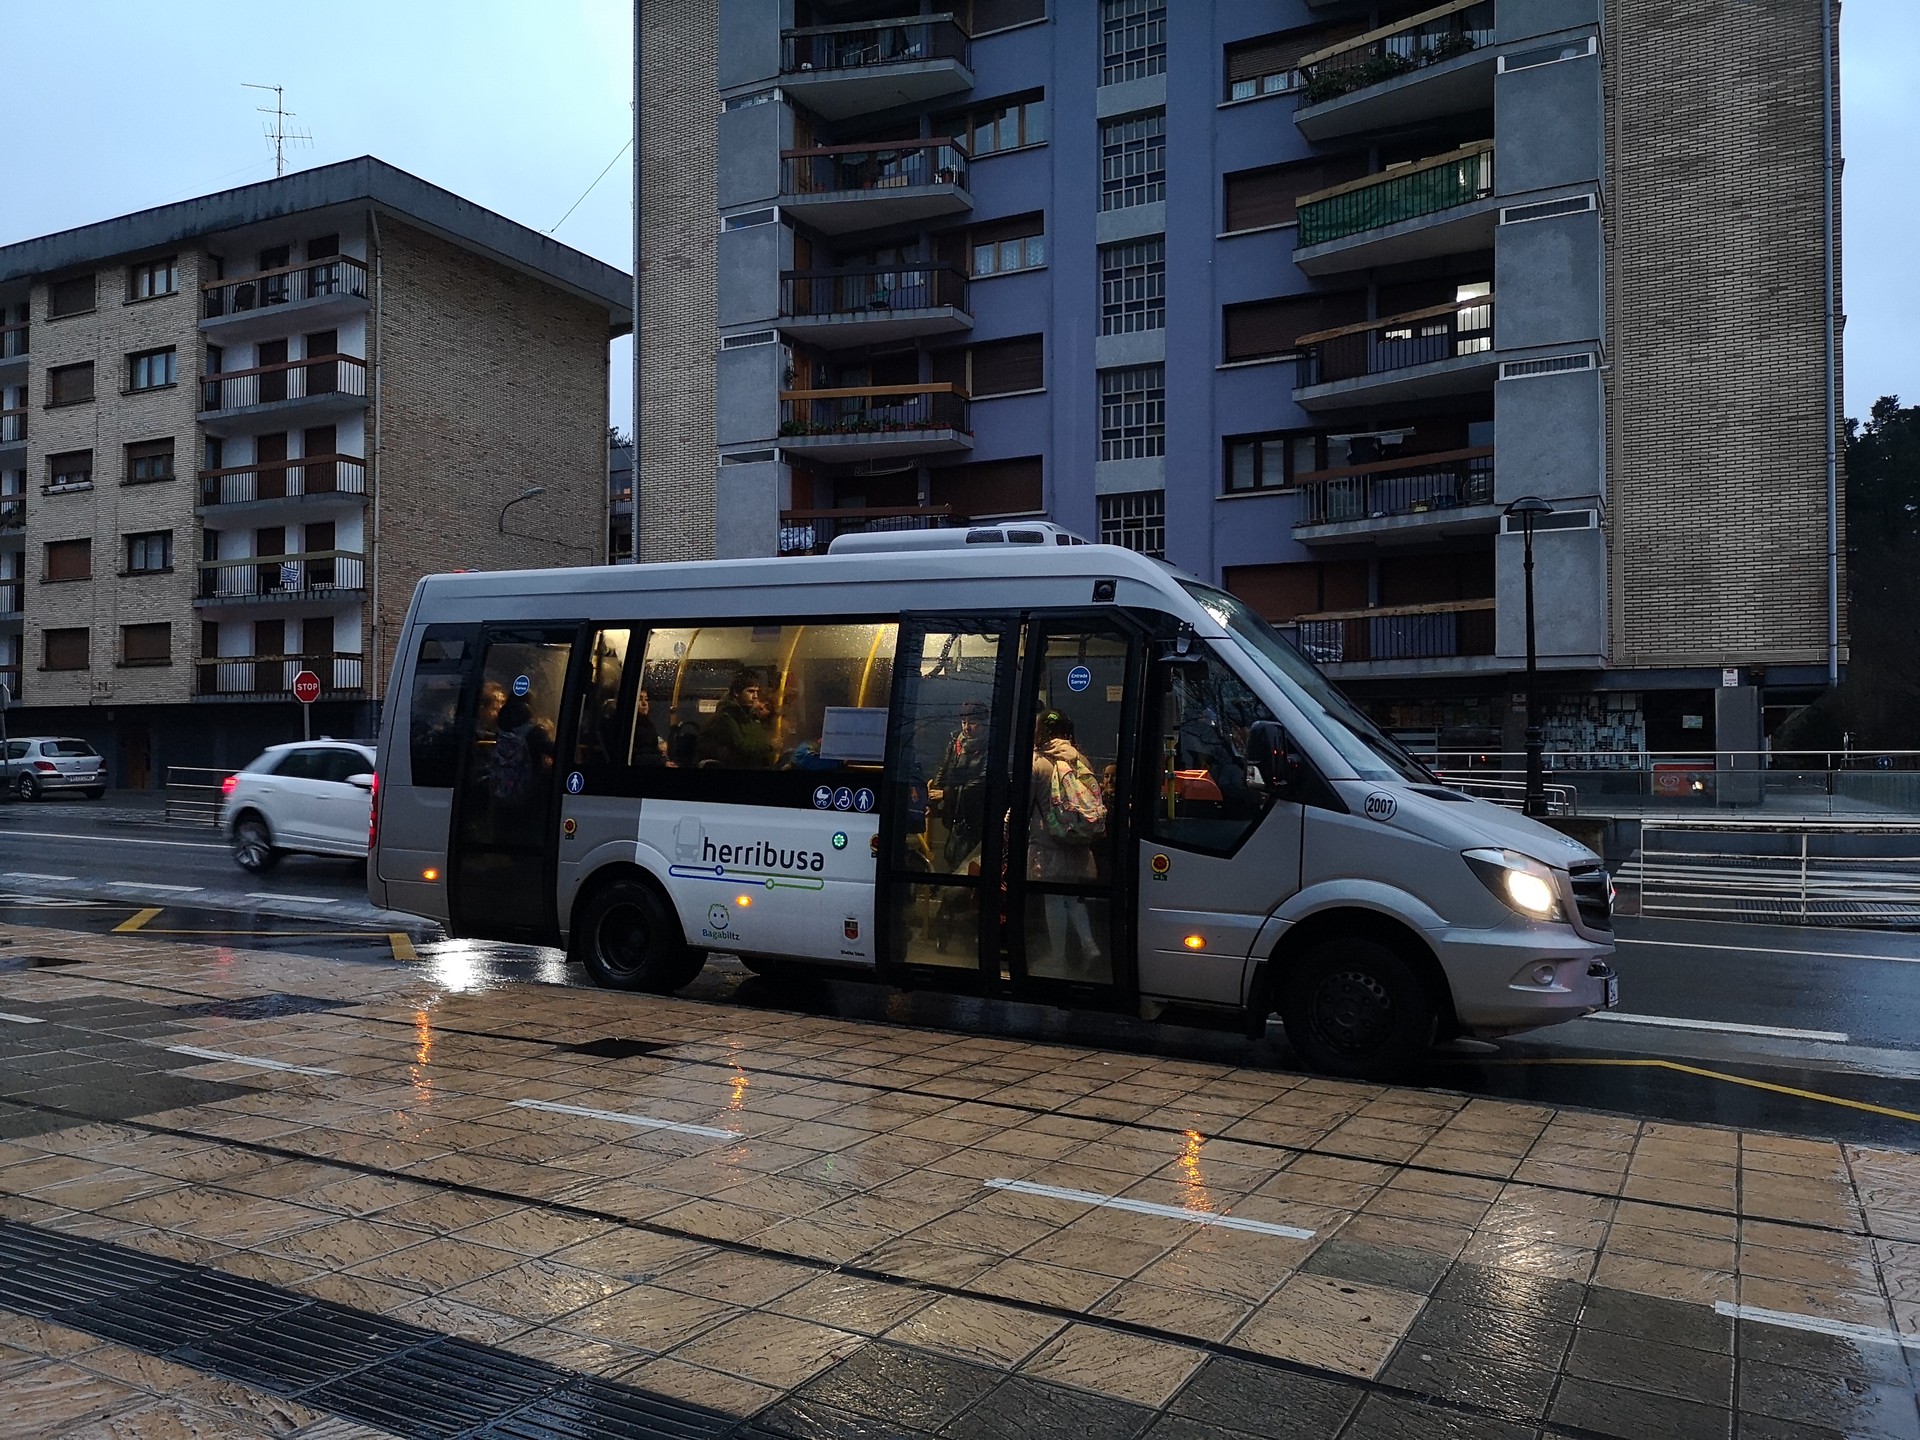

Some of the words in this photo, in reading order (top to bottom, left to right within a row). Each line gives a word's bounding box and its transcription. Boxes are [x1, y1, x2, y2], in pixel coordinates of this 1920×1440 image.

[297, 683, 318, 691] STOP
[1367, 797, 1394, 815] 2007
[702, 837, 825, 872] herribusa
[702, 929, 741, 941] Bagabiltz
